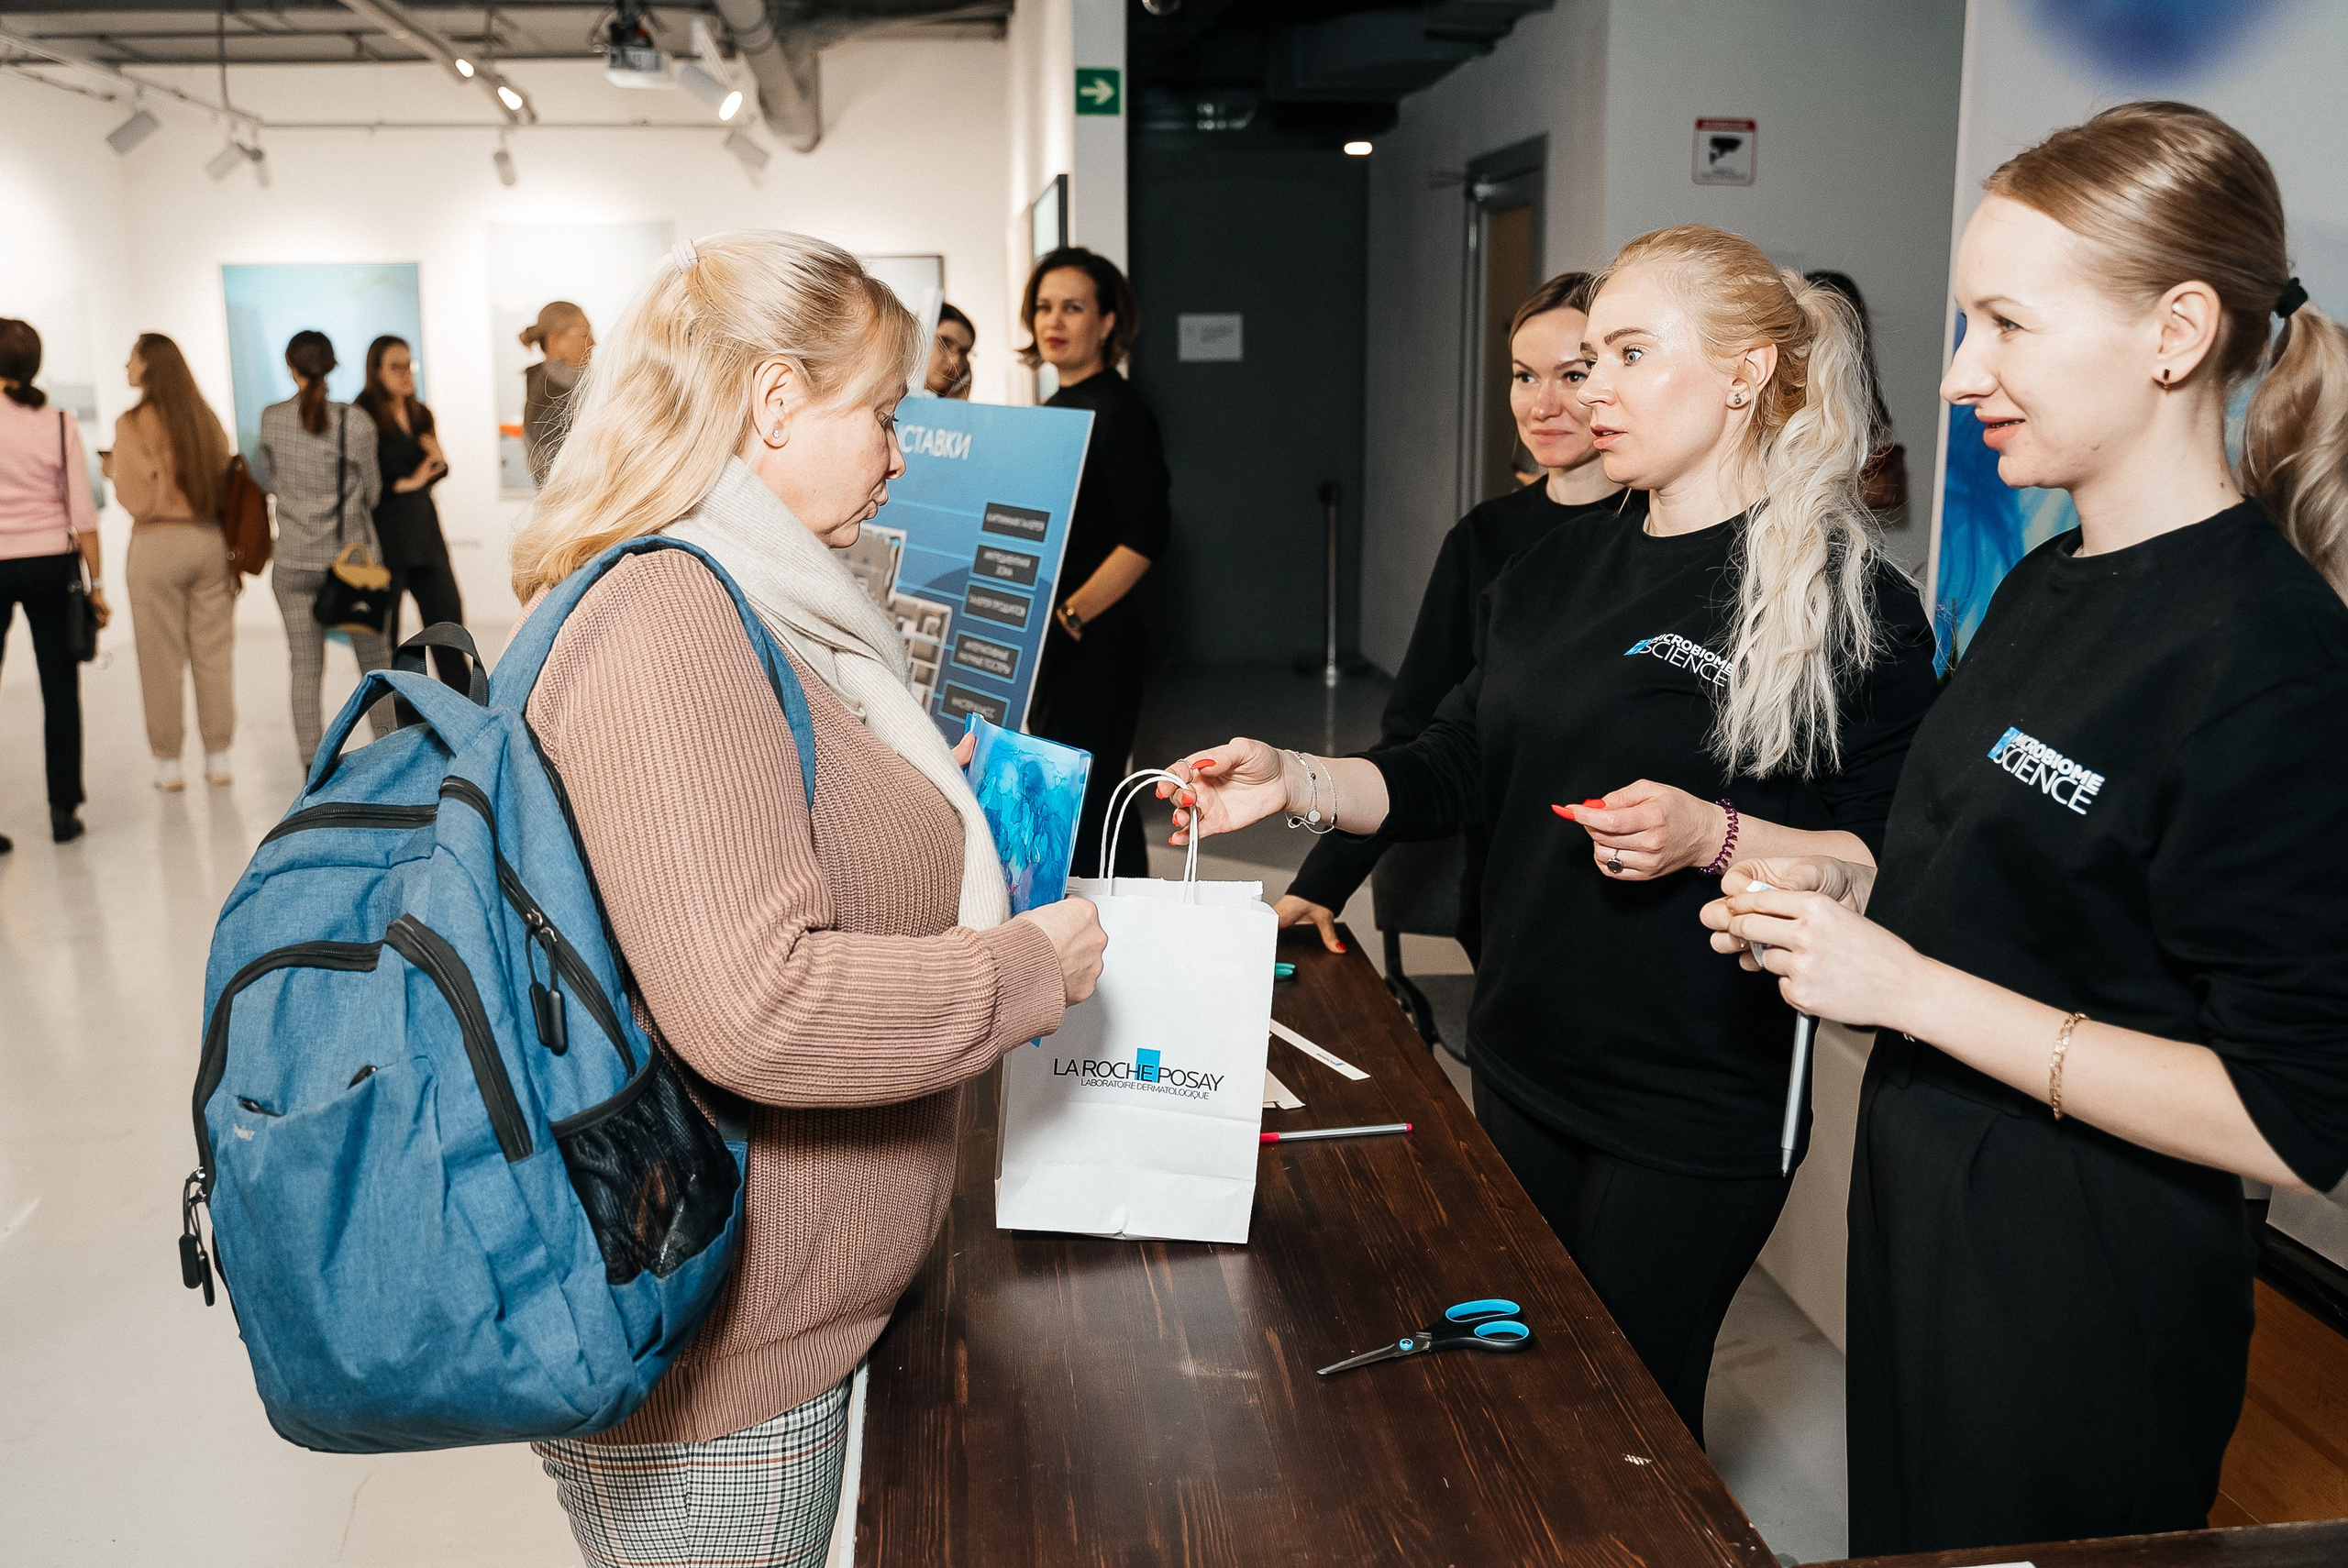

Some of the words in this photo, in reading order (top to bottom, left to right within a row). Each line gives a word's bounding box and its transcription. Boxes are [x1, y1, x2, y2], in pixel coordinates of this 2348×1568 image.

[1639, 641, 1731, 687] SCIENCE
[1993, 744, 2098, 815] SCIENCE
[2011, 733, 2105, 791] MICROBIOME
[1054, 1058, 1080, 1077] LA
[1082, 1060, 1154, 1082] ROCHE
[1157, 1066, 1224, 1091] POSAY
[1080, 1078, 1135, 1089] LABORATOIRE
[1137, 1082, 1210, 1099] DERMATOLOGIQUE
